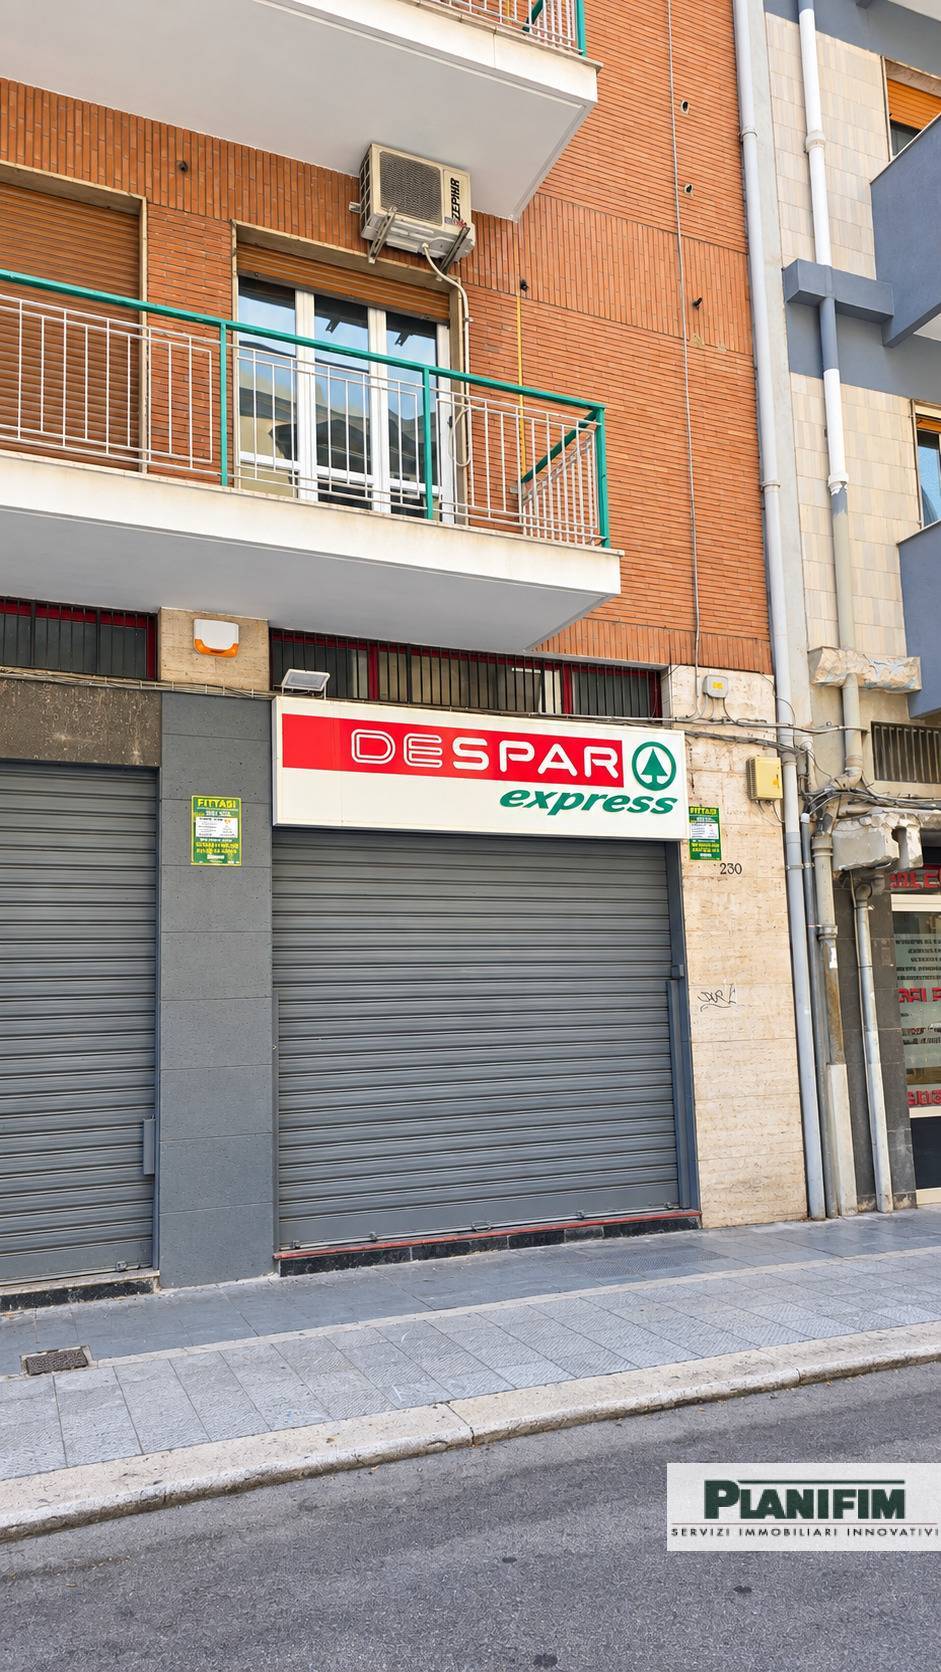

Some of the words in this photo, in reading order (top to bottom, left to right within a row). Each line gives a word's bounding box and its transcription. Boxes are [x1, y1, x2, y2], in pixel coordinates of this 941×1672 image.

[351, 728, 619, 779] DESPAR
[499, 788, 678, 816] express
[719, 863, 743, 875] 230
